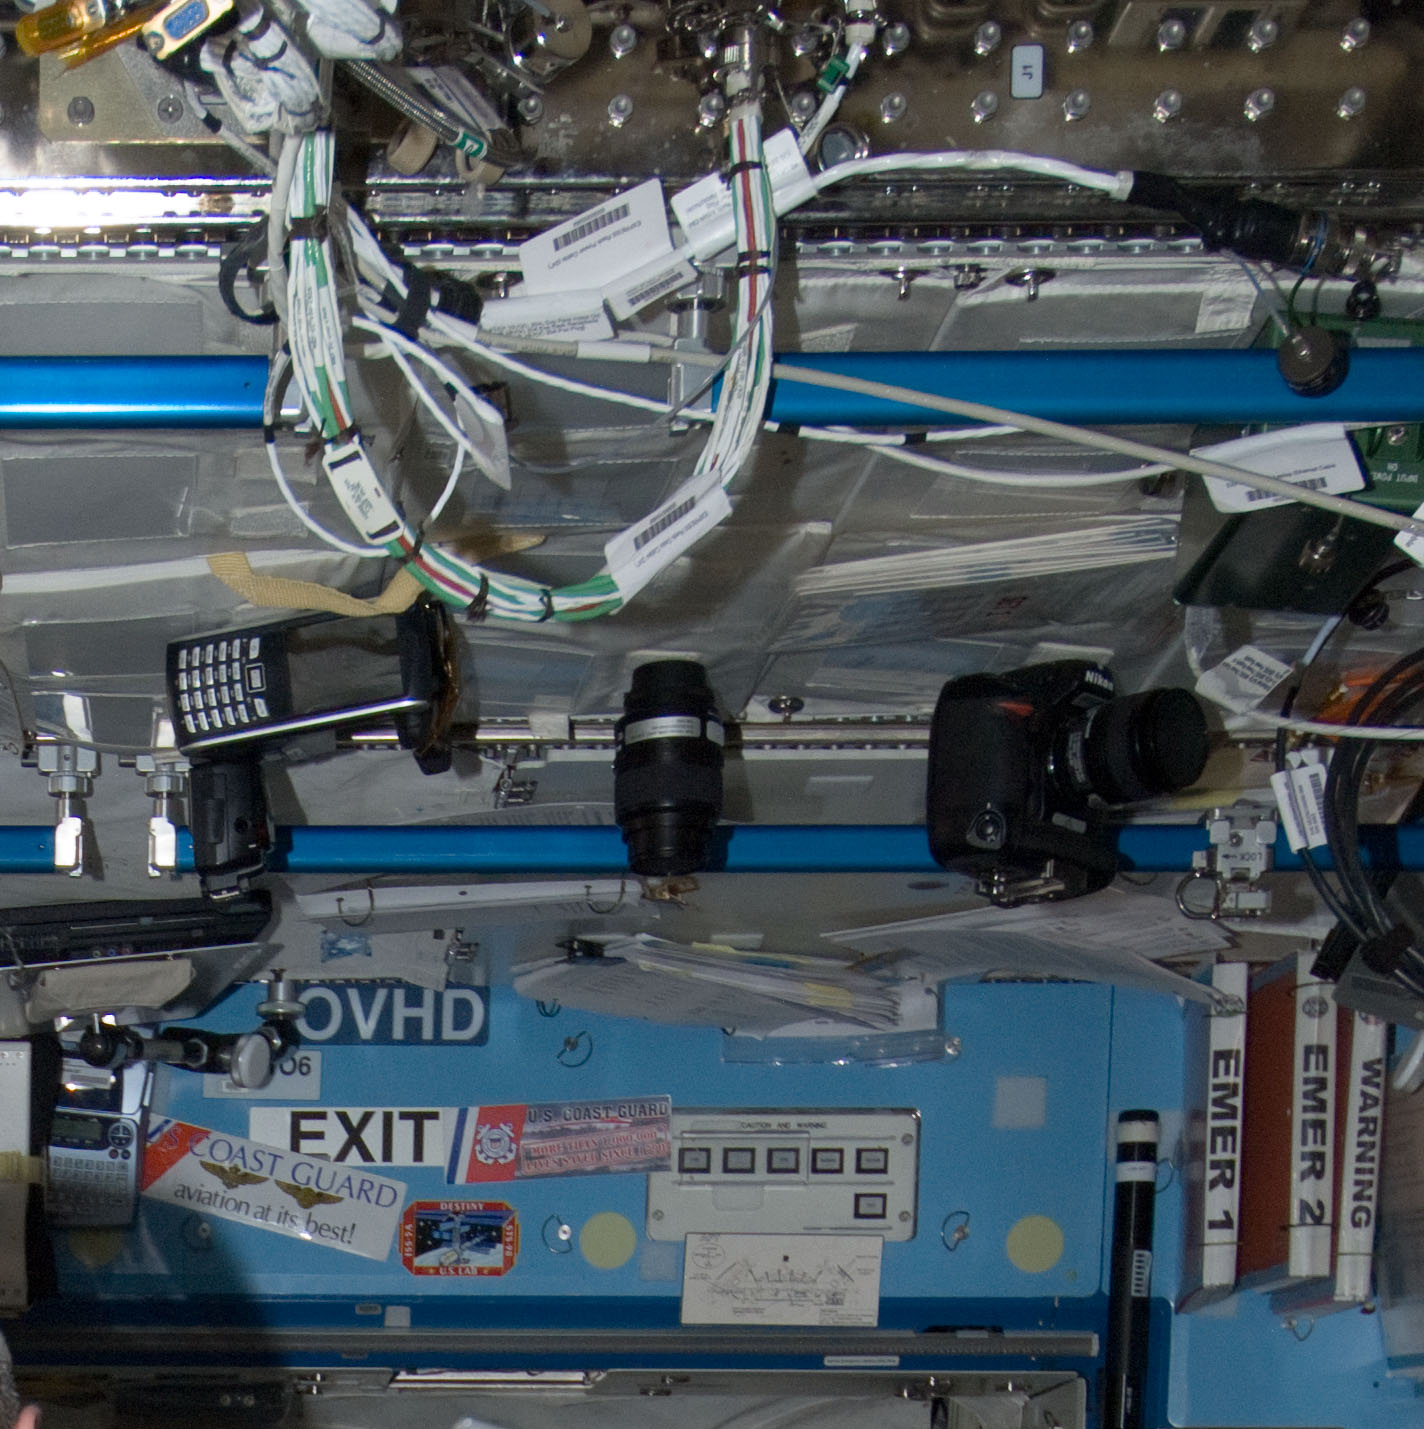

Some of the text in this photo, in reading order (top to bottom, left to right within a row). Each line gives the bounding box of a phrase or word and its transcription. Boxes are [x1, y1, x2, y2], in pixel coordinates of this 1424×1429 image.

[1022, 64, 1032, 79] J1
[1083, 669, 1116, 691] Nikon
[296, 987, 485, 1041] OVHD
[289, 1110, 440, 1163] EXIT
[563, 1104, 614, 1120] COAST
[618, 1102, 668, 1118] GUARD
[1299, 1044, 1329, 1226] EMER 2
[1208, 1048, 1242, 1230] EMER 1
[1351, 1057, 1384, 1229] WARNING
[188, 1131, 285, 1177] COAST
[291, 1160, 398, 1208] GUARD
[173, 1181, 251, 1217] aviation
[253, 1203, 272, 1223] at
[305, 1215, 357, 1245] best!
[439, 1201, 485, 1211] DESTINY
